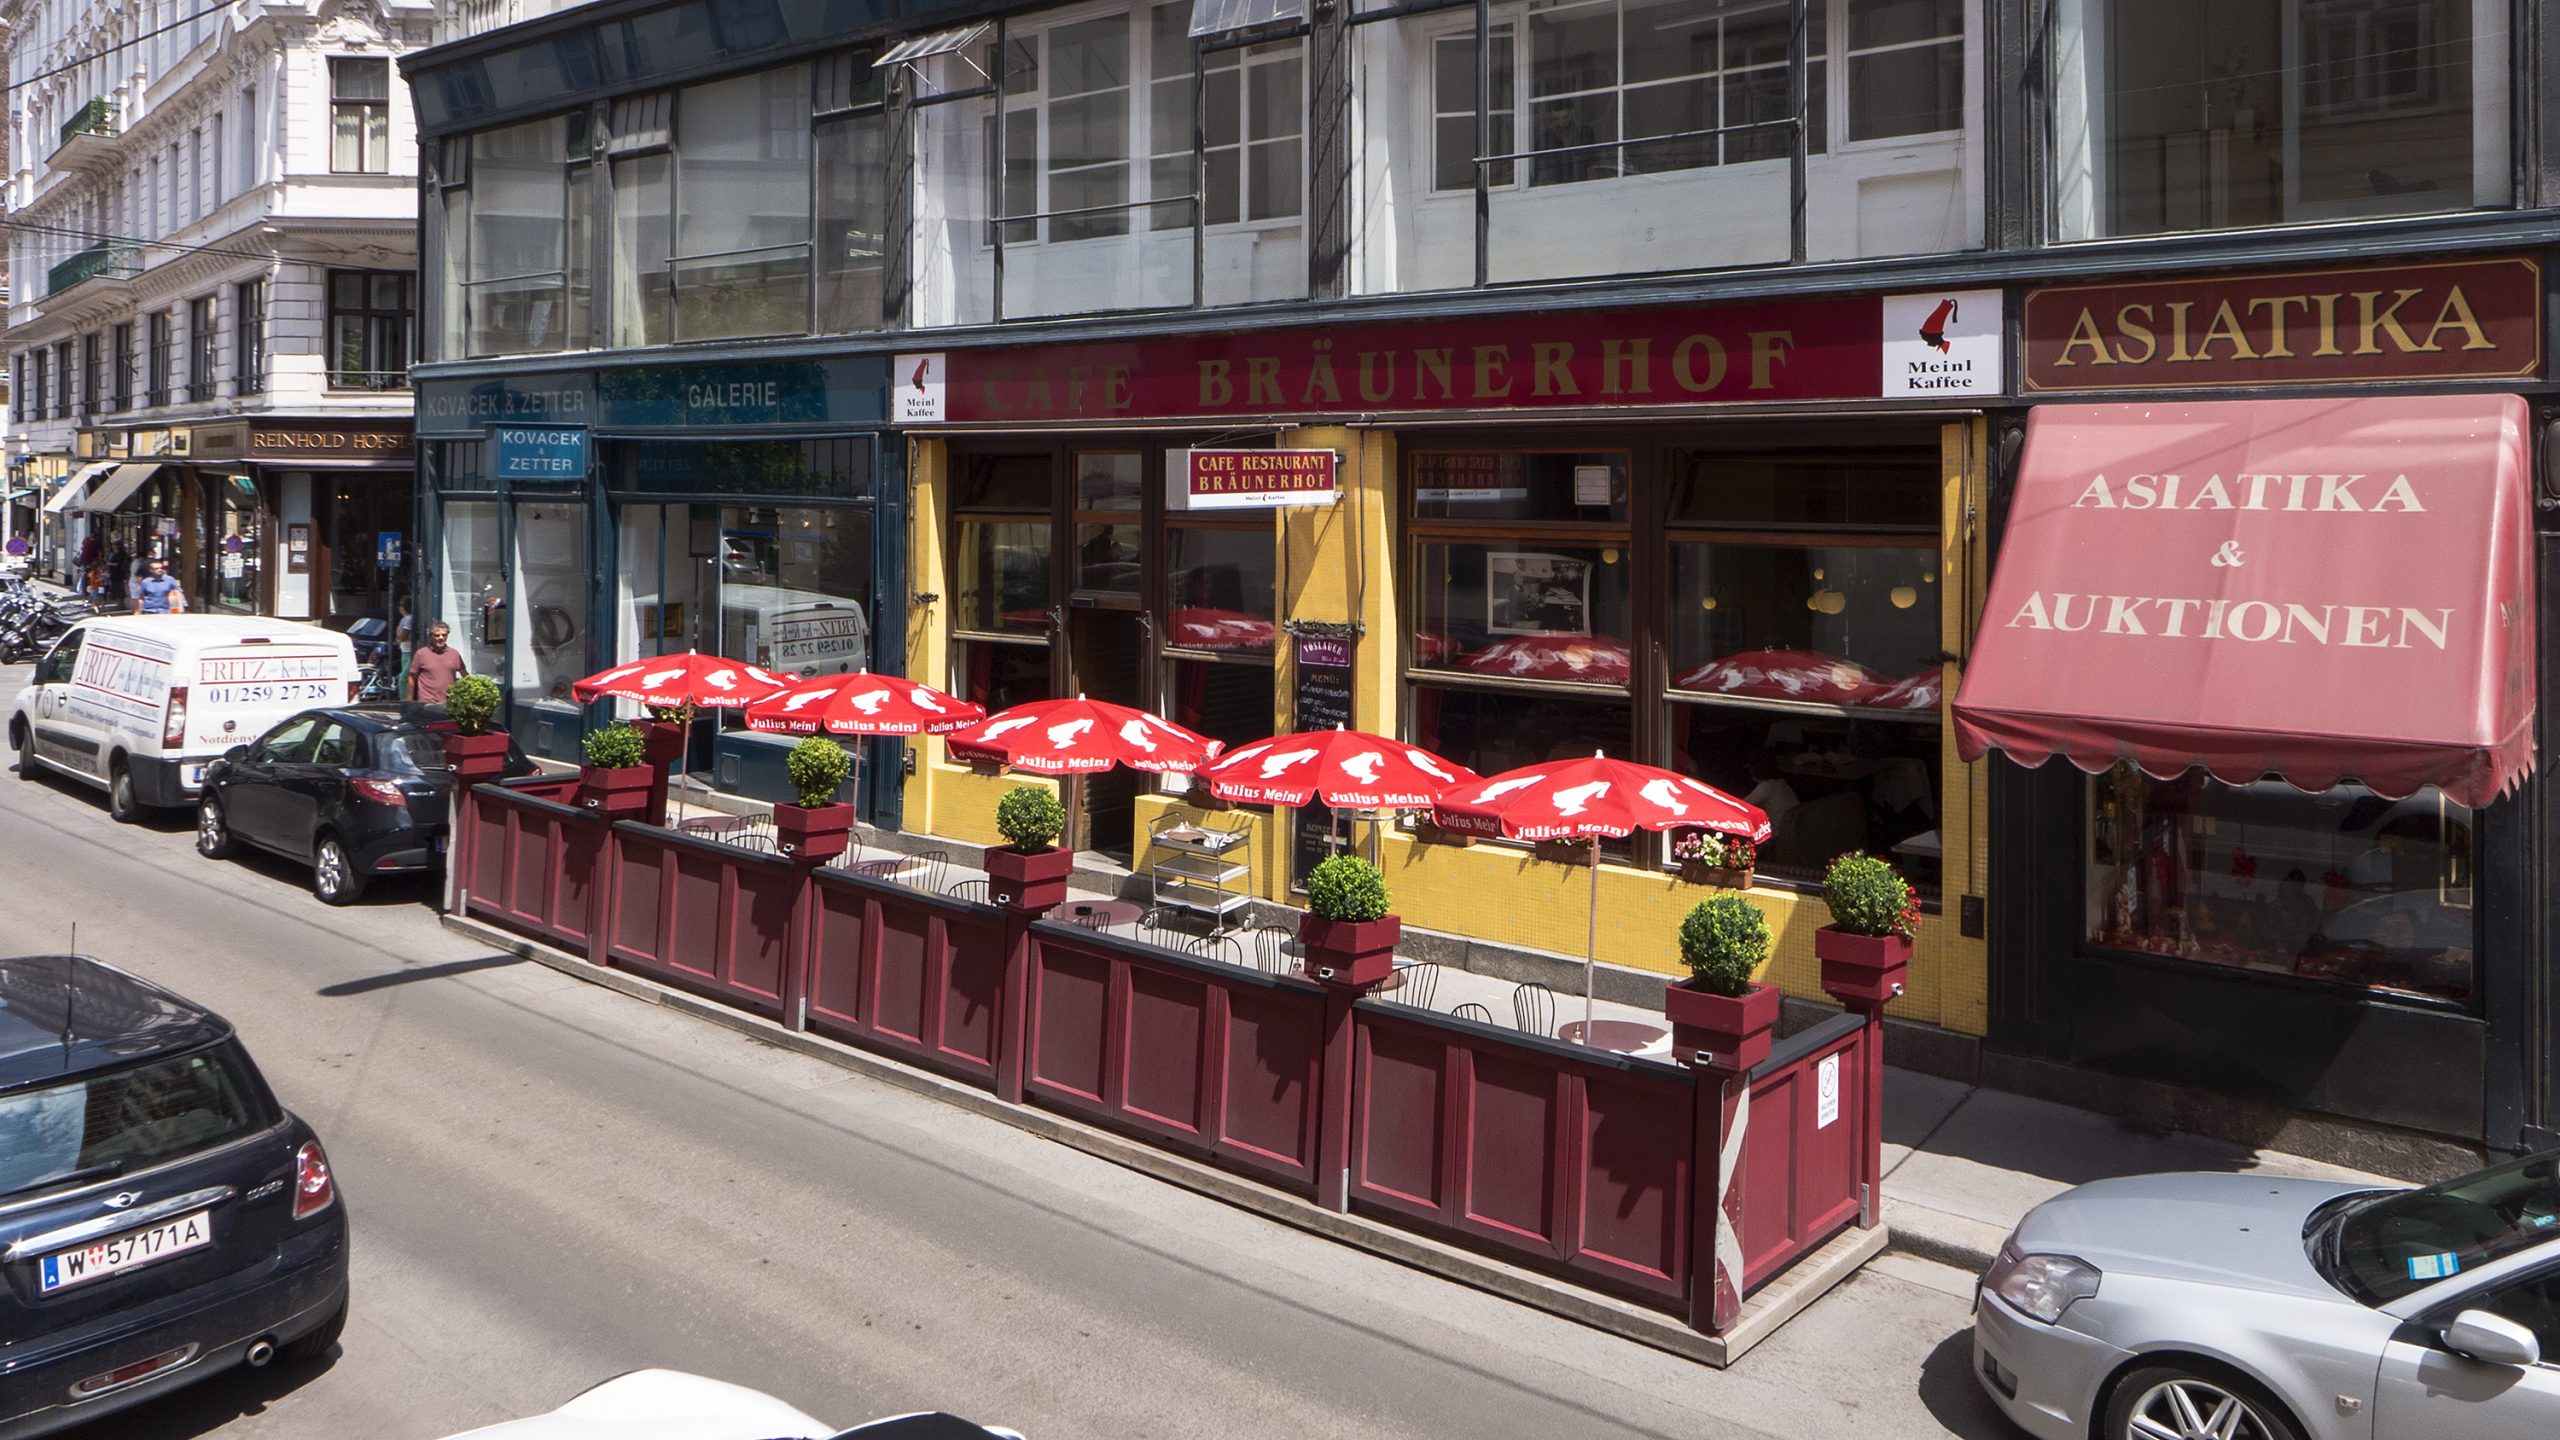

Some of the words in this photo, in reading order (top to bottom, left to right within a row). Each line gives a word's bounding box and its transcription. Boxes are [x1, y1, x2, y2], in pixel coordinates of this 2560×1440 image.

[2053, 284, 2497, 367] ASIATIKA
[984, 363, 1134, 412] CAFE
[1197, 329, 1796, 407] BRÄUNERHOF
[1908, 360, 1972, 374] Meinl
[1908, 376, 1973, 389] Kaffee
[688, 381, 777, 409] GALERIE
[906, 398, 935, 407] Meinl
[427, 393, 499, 417] KOVACEK
[505, 393, 515, 415] &
[521, 390, 584, 414] ZETTER
[906, 408, 935, 417] Kaffee
[253, 433, 346, 449] REINHOLD
[502, 431, 581, 446] KOVACEK
[509, 457, 573, 471] ZETTER
[1198, 456, 1235, 471] CAFE
[1241, 455, 1325, 471] RESTAURANT
[1199, 471, 1326, 491] BRÄUNERHOF
[2069, 473, 2427, 513] ASIATIKA
[2209, 539, 2246, 568] &
[2005, 590, 2456, 650] AUKTIONEN
[78, 648, 122, 690] FRITZ
[200, 660, 267, 681] FRITZ
[209, 686, 274, 704] 01/259
[280, 685, 300, 701] 27
[307, 684, 327, 699] 28
[702, 696, 738, 705] Julius
[750, 718, 787, 729] Julius
[789, 720, 817, 732] Meinl
[831, 719, 876, 731] Julius
[879, 722, 917, 733] Meinl
[928, 721, 954, 733] Julius
[199, 733, 257, 746] Notdienst
[1015, 755, 1064, 769] Julius
[1068, 757, 1111, 769] Meinl
[1216, 782, 1260, 799] Julius
[1264, 788, 1303, 804] Meinl
[1329, 791, 1380, 805] Julius
[1383, 793, 1432, 805] Meinl
[1442, 813, 1472, 829] Julius
[1515, 823, 1571, 841] Julius
[67, 1252, 85, 1277] W
